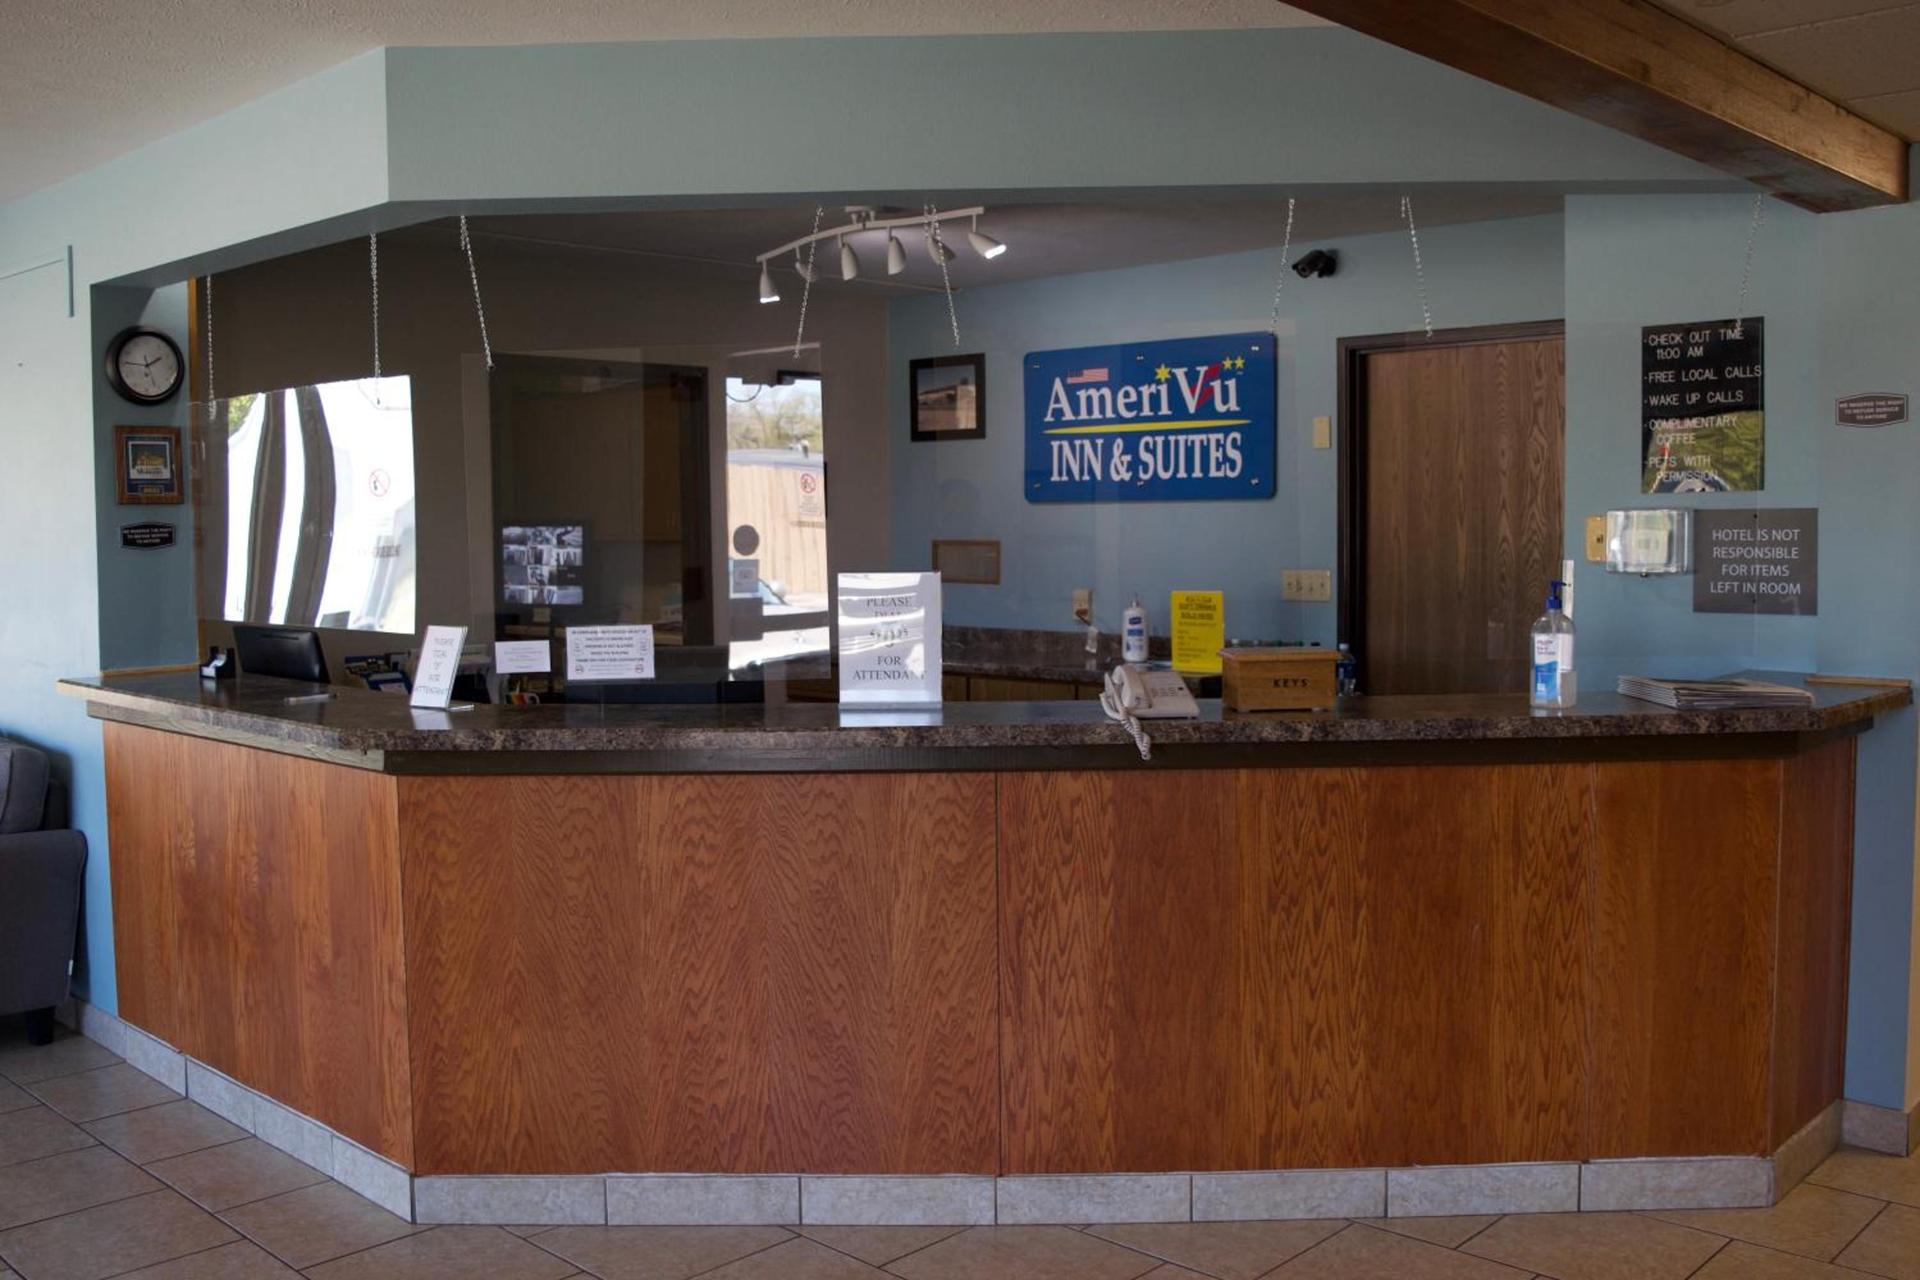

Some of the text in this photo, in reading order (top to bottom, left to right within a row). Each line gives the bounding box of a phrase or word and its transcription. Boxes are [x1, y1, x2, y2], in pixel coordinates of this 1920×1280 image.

[1649, 328, 1744, 346] CHECK OUT TIME
[1687, 346, 1704, 358] AM
[1649, 365, 1762, 383] FREE LOCAL CALLS
[1044, 365, 1241, 422] AmeriVu
[1649, 390, 1744, 406] WAKE UP CALLS
[1650, 416, 1738, 430] COMPLIMENTARY
[1656, 433, 1696, 445] COFFEE
[1051, 431, 1243, 482] INN & SUITES
[1684, 455, 1711, 467] WITH
[1712, 529, 1800, 541] HOTEL IS NOT
[1713, 547, 1800, 559] RESPONSIBLE
[1722, 564, 1790, 577] FOR ITEMS
[1710, 582, 1801, 595] LEFT IN ROOM
[866, 597, 912, 607] PLEASE
[877, 655, 902, 666] FOR
[1272, 678, 1309, 688] KEYS
